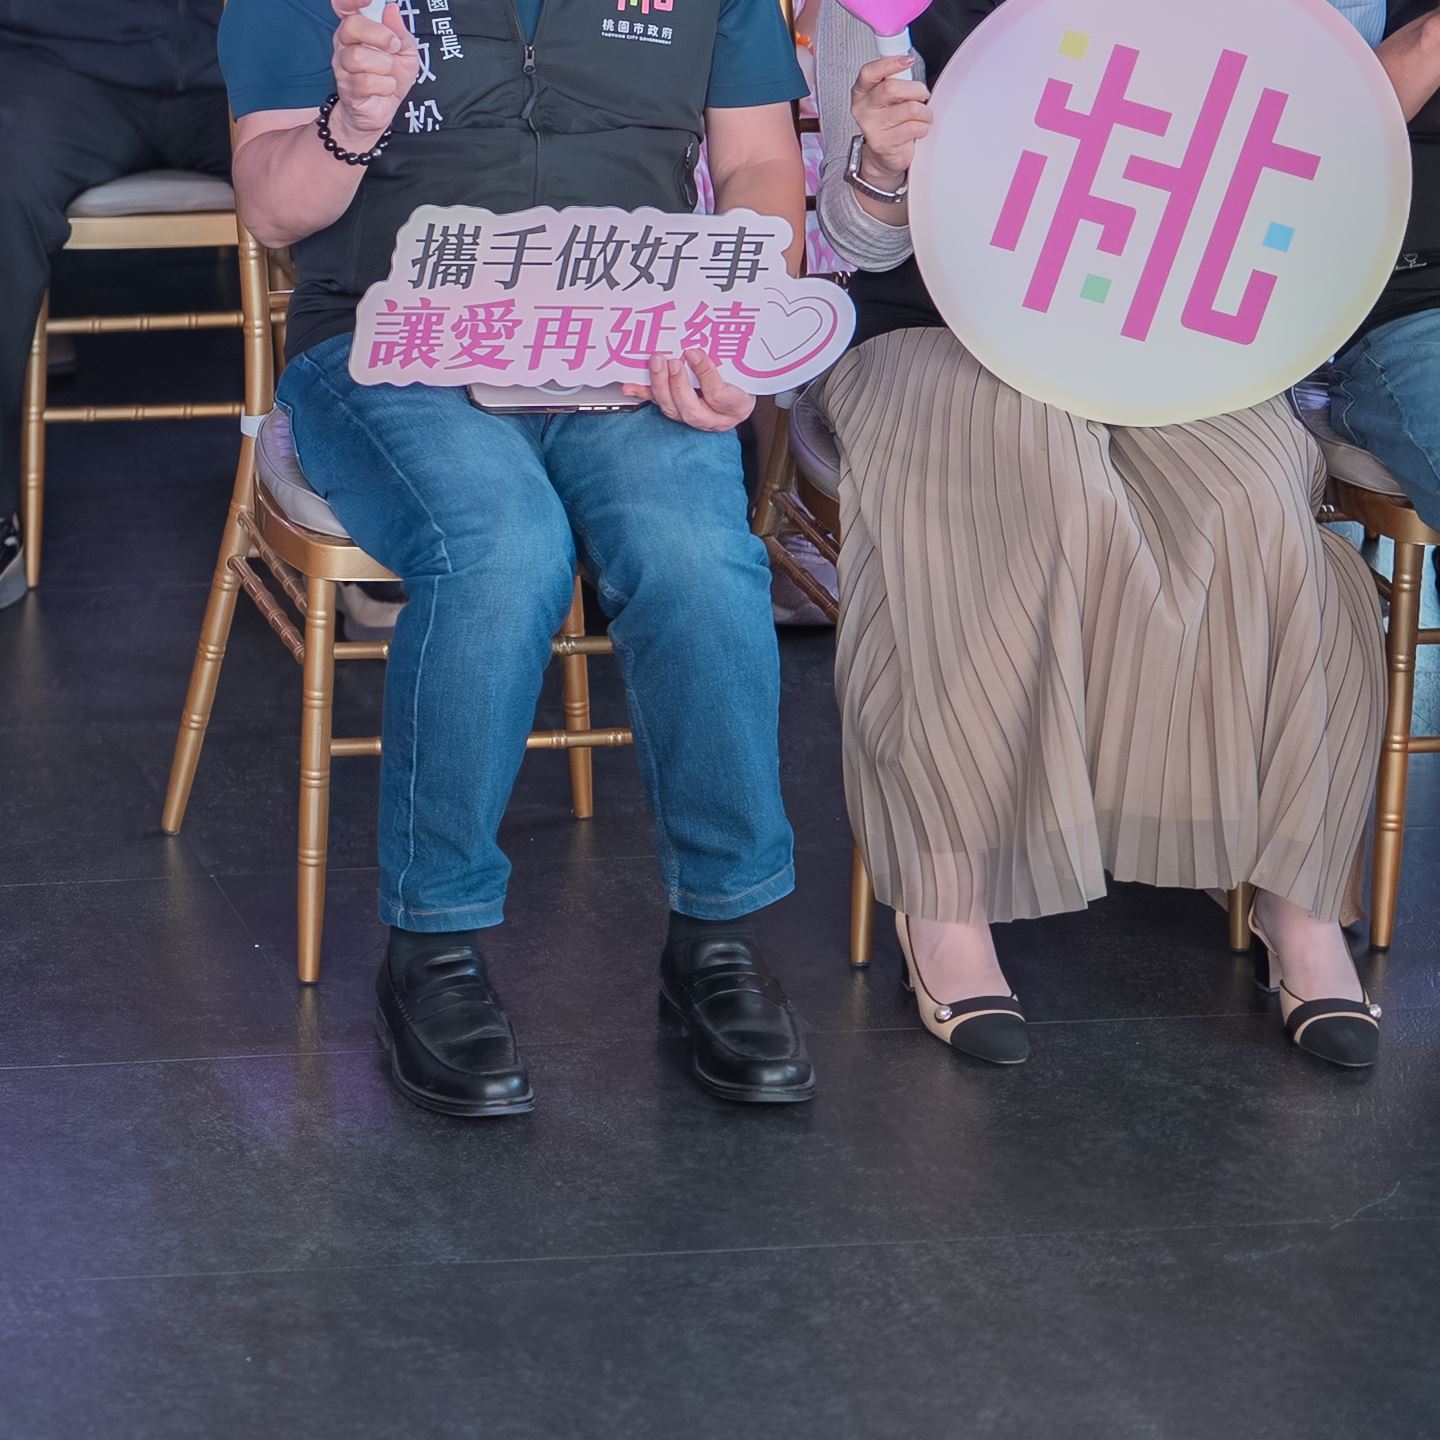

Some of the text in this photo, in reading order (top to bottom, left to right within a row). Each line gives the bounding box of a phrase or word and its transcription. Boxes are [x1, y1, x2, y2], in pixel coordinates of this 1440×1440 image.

[602, 18, 673, 40] 桃園市政府
[408, 223, 776, 293] 攜手做好事
[368, 297, 761, 372] 讓愛再延續
